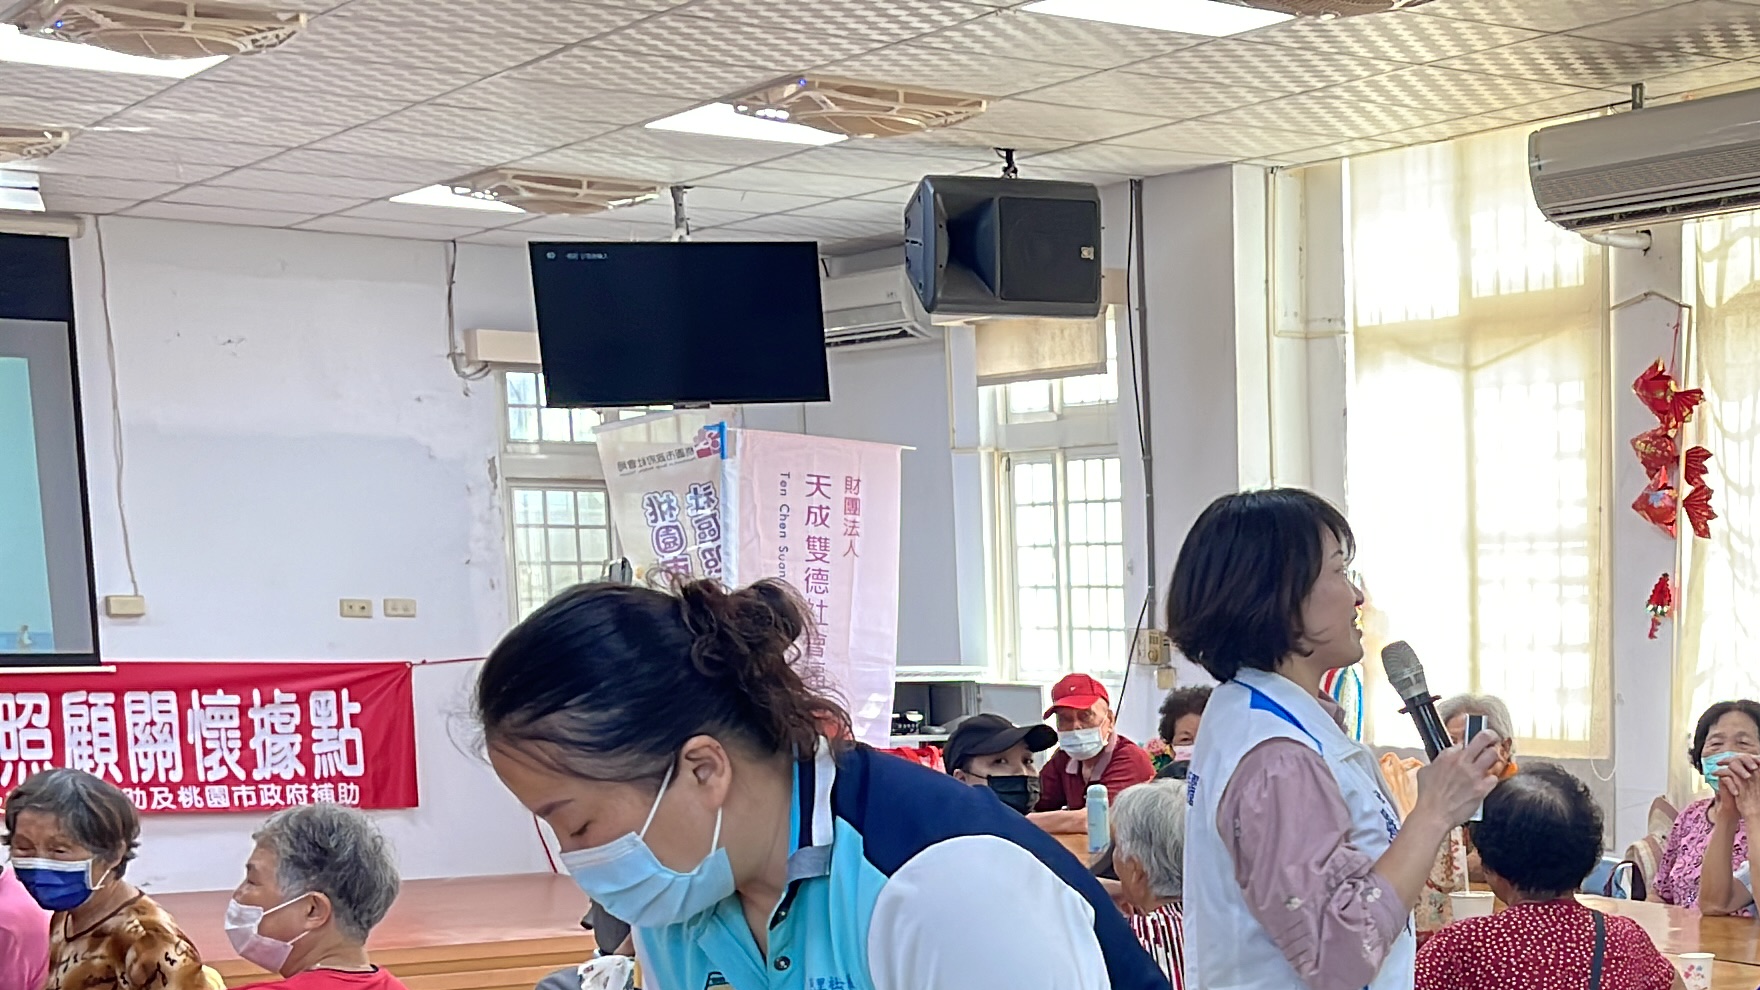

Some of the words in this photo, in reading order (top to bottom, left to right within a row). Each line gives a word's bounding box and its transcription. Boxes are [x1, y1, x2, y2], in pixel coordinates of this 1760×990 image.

[779, 472, 791, 496] Ten
[779, 503, 790, 539] Chen
[842, 474, 862, 559] 財團法人
[0, 687, 365, 787] 照顧關懷據點
